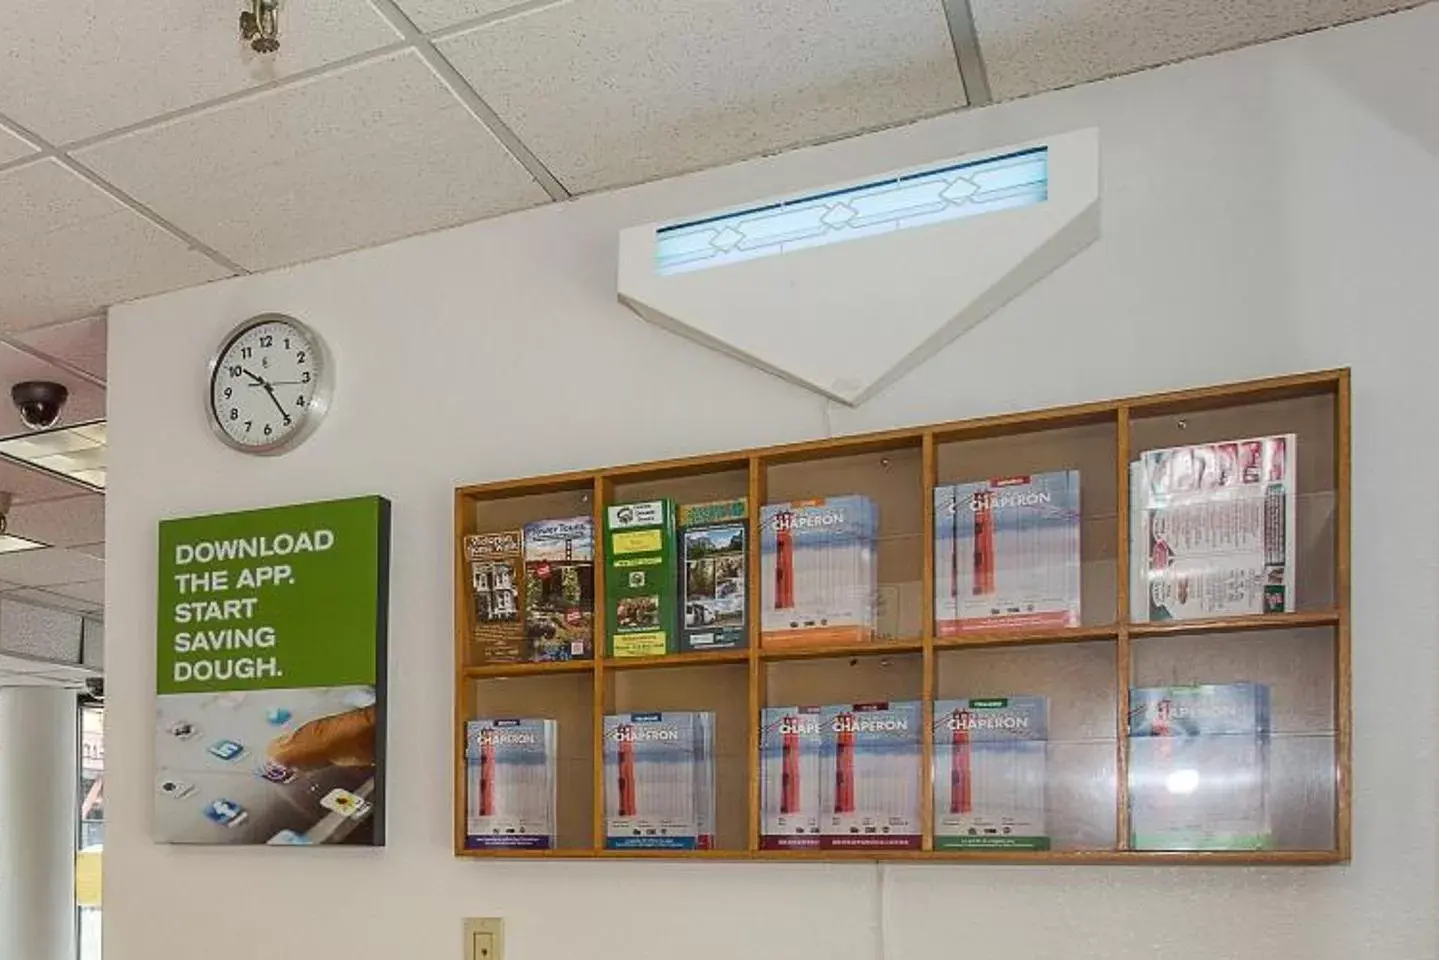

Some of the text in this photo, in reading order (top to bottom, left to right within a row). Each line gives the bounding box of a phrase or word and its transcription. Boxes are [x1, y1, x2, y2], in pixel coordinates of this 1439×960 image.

[260, 336, 272, 347] 12
[284, 338, 290, 349] 1
[241, 347, 252, 359] 11
[297, 351, 305, 364] 2
[229, 366, 242, 377] 10
[302, 371, 311, 383] 3
[224, 387, 232, 399] 9
[296, 395, 305, 407] 4
[230, 408, 238, 420] 8
[283, 415, 292, 426] 5
[244, 421, 252, 432] 7
[264, 424, 272, 435] 6
[969, 491, 1051, 513] CHAPERON
[771, 513, 845, 532] CHAPERON
[175, 530, 334, 564] DOWNLOAD
[174, 564, 295, 594] THE APP.
[174, 598, 258, 623] START
[174, 627, 276, 652] SAVING
[174, 656, 283, 682] DOUGH.
[832, 717, 909, 734] CHAPERON
[947, 715, 1029, 732] CHAPERON
[477, 731, 536, 746] CHAPERON
[613, 729, 679, 743] CHAPERON
